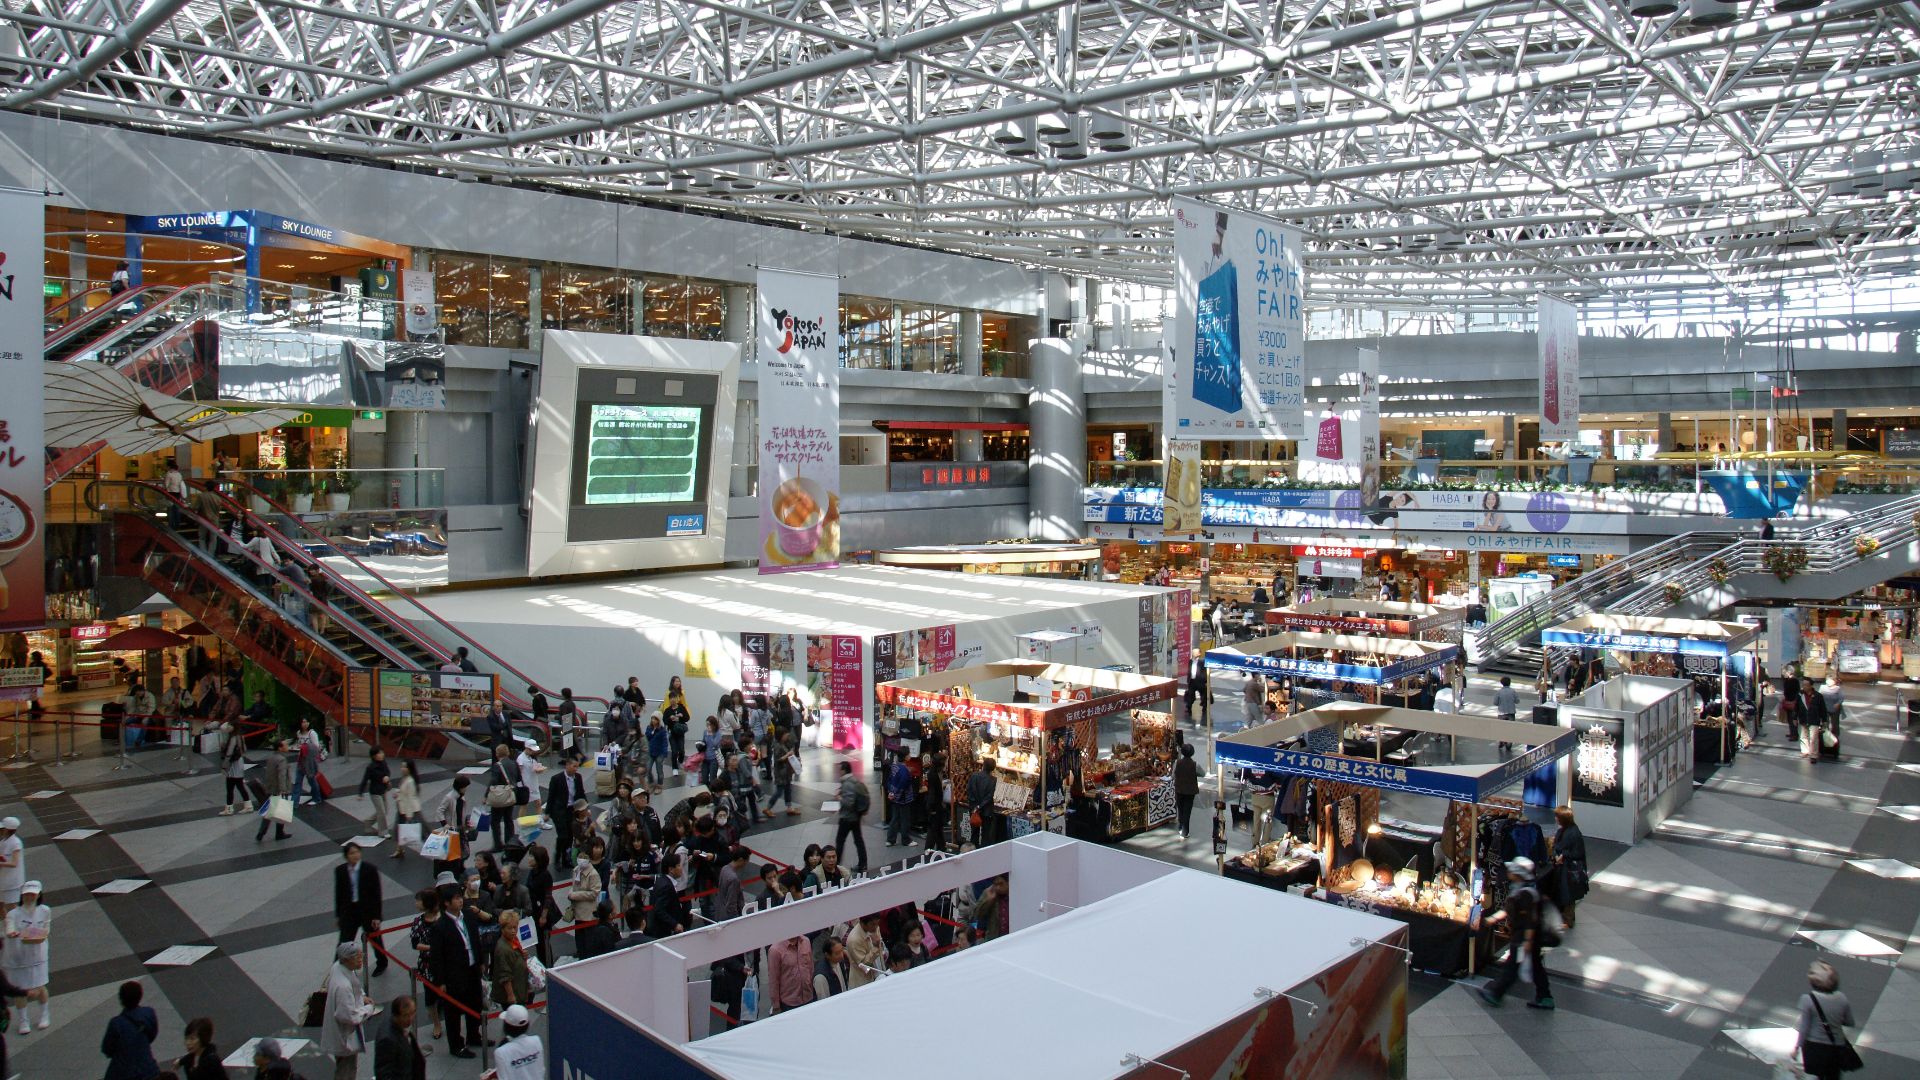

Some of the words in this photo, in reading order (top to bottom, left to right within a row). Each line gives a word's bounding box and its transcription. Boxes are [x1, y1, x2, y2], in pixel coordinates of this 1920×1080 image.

[158, 218, 178, 228] SKY
[180, 215, 222, 226] LOUNGE
[282, 220, 299, 231] SKY
[300, 222, 332, 240] LOUNGE
[1256, 228, 1284, 260] Oh!
[1256, 260, 1300, 290] みやげ
[1198, 296, 1221, 316] 空港で
[1258, 289, 1298, 320] FAIR
[771, 308, 822, 334] Yokoso!
[1198, 314, 1231, 333] おみやげ
[776, 331, 826, 354] JAPAN
[1196, 338, 1221, 358] 買うと
[1258, 330, 1287, 348] ¥3000
[1258, 352, 1300, 369] お買い上げ
[1196, 360, 1230, 389] チャンス!
[1258, 372, 1300, 387] ごとに1回の
[1260, 389, 1301, 406] 抽選チャンス!
[764, 440, 832, 452] ホットキャラメル
[774, 452, 823, 464] アイスクリーム
[1432, 494, 1460, 504] HABA
[1318, 548, 1352, 558] 丸井今井
[1274, 750, 1407, 783] アイヌの歴史と文化展
